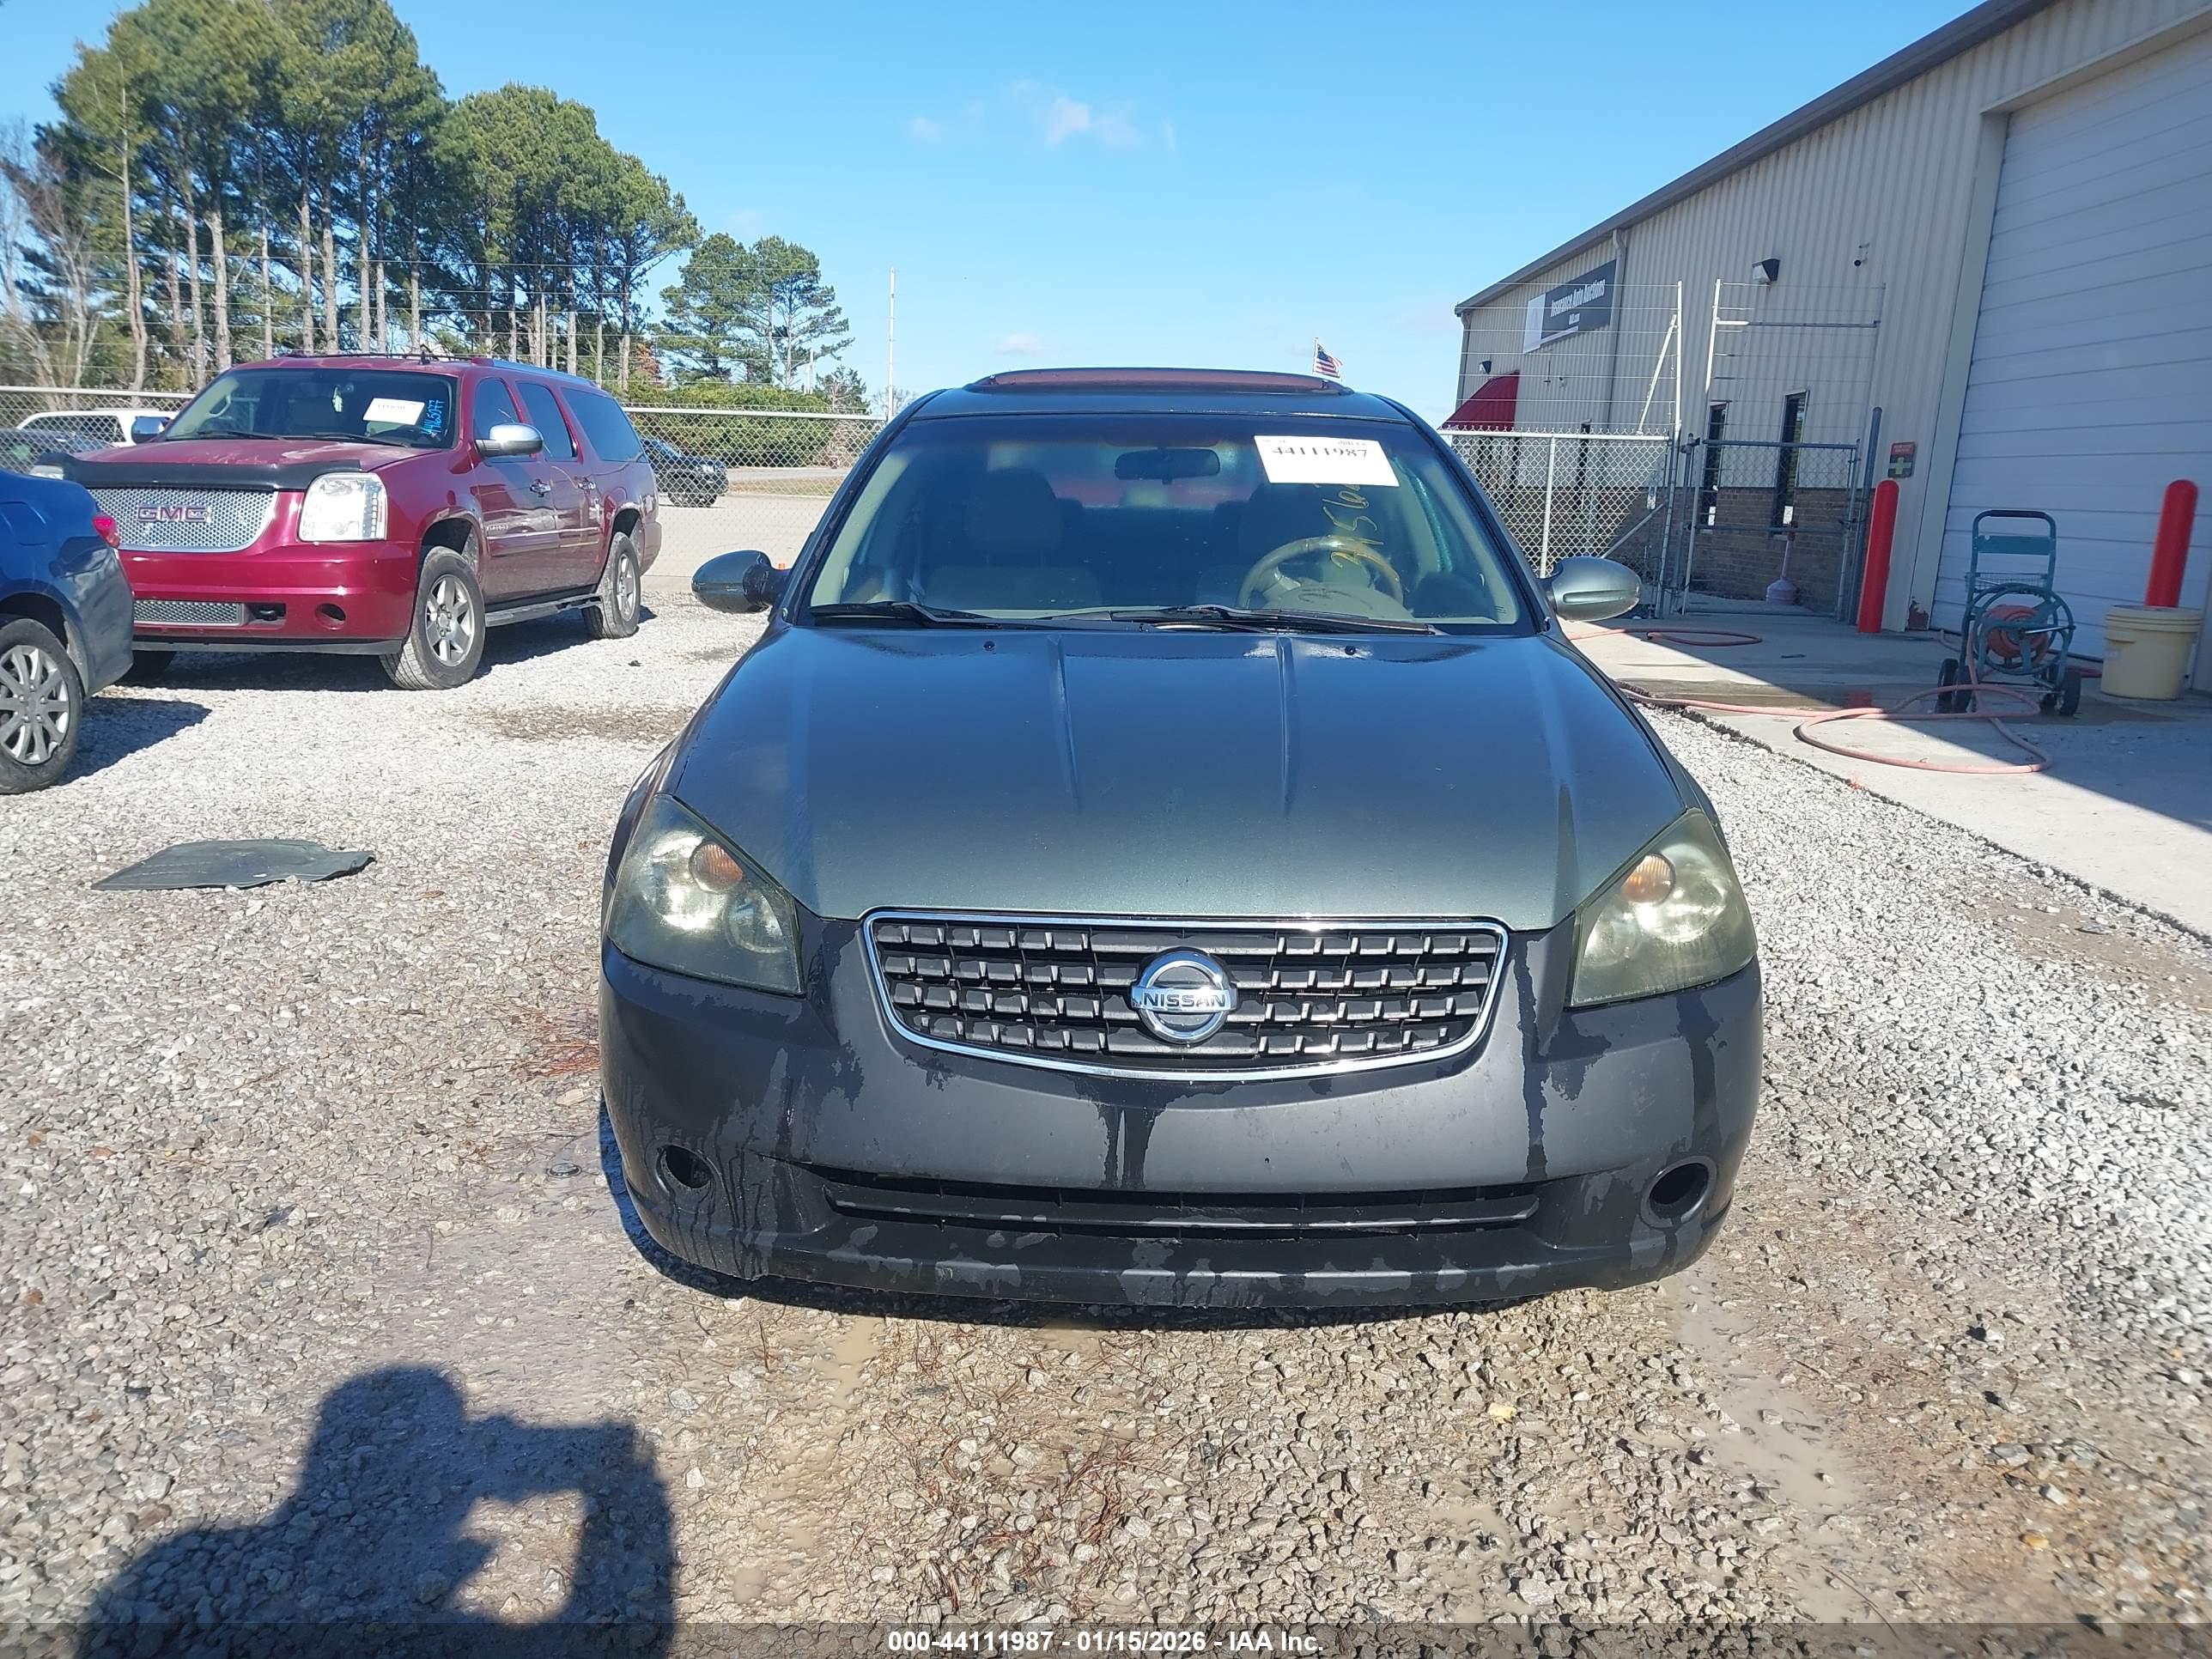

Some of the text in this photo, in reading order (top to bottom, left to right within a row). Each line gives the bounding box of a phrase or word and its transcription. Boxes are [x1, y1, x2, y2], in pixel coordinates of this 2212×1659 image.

[1273, 446, 1368, 458] 44111987
[137, 507, 208, 522] GMC
[1143, 993, 1226, 1007] NISSAN
